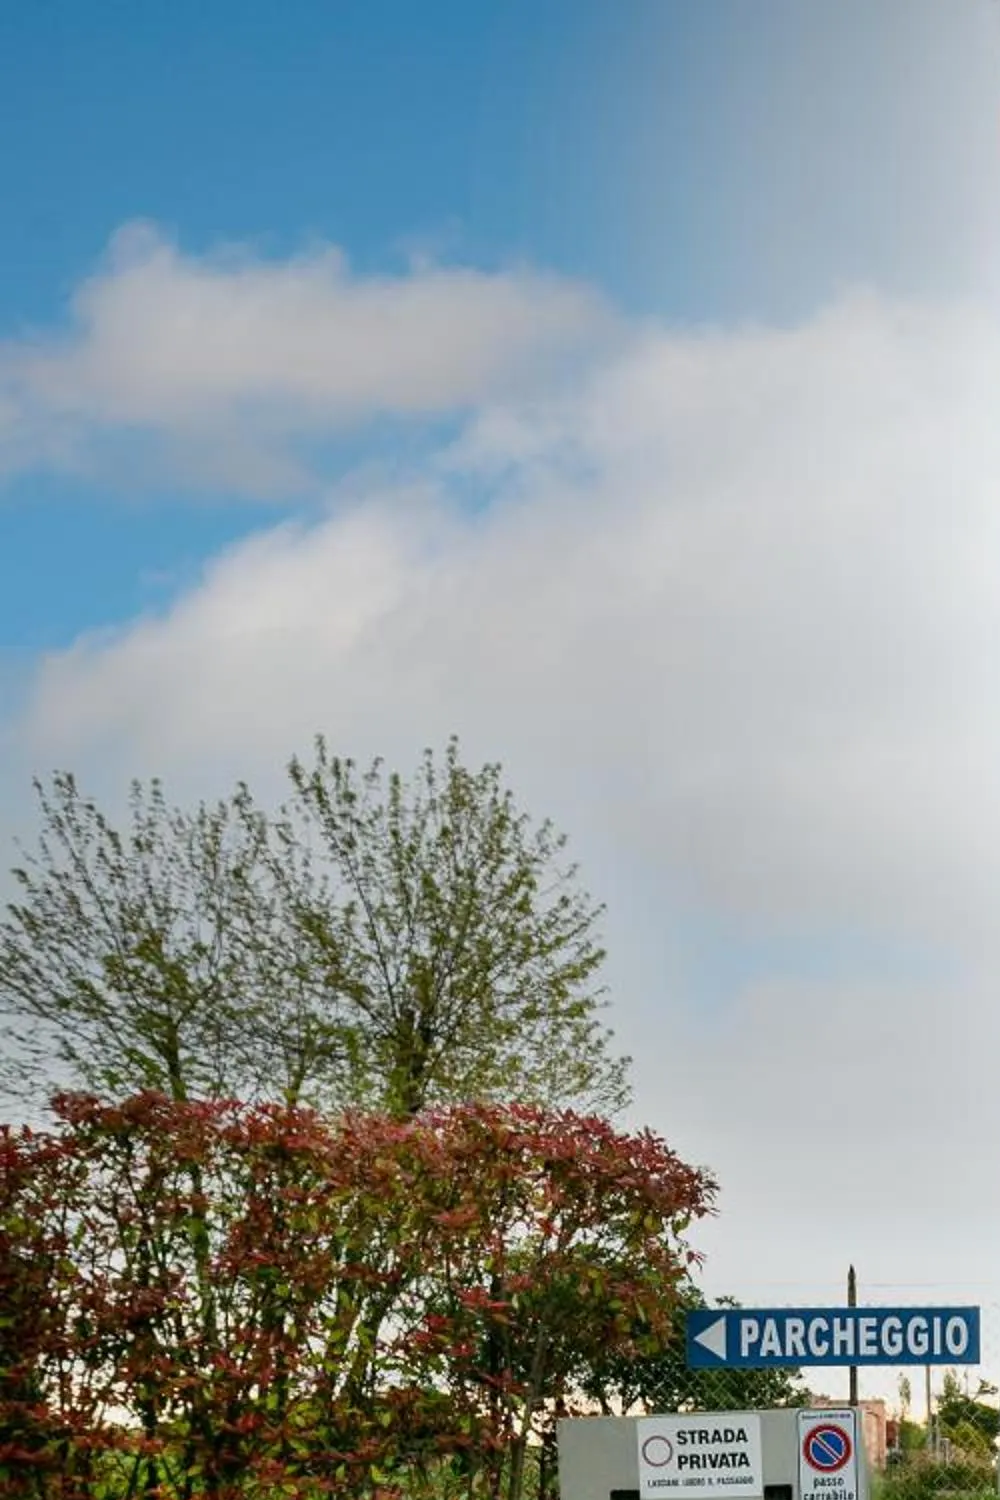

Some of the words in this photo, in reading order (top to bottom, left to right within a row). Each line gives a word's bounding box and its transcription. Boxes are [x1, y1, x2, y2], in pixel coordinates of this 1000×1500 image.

[740, 1315, 969, 1357] PARCHEGGIO
[676, 1427, 749, 1446] STRADA
[677, 1451, 751, 1470] PRIVATA
[813, 1477, 845, 1489] passo
